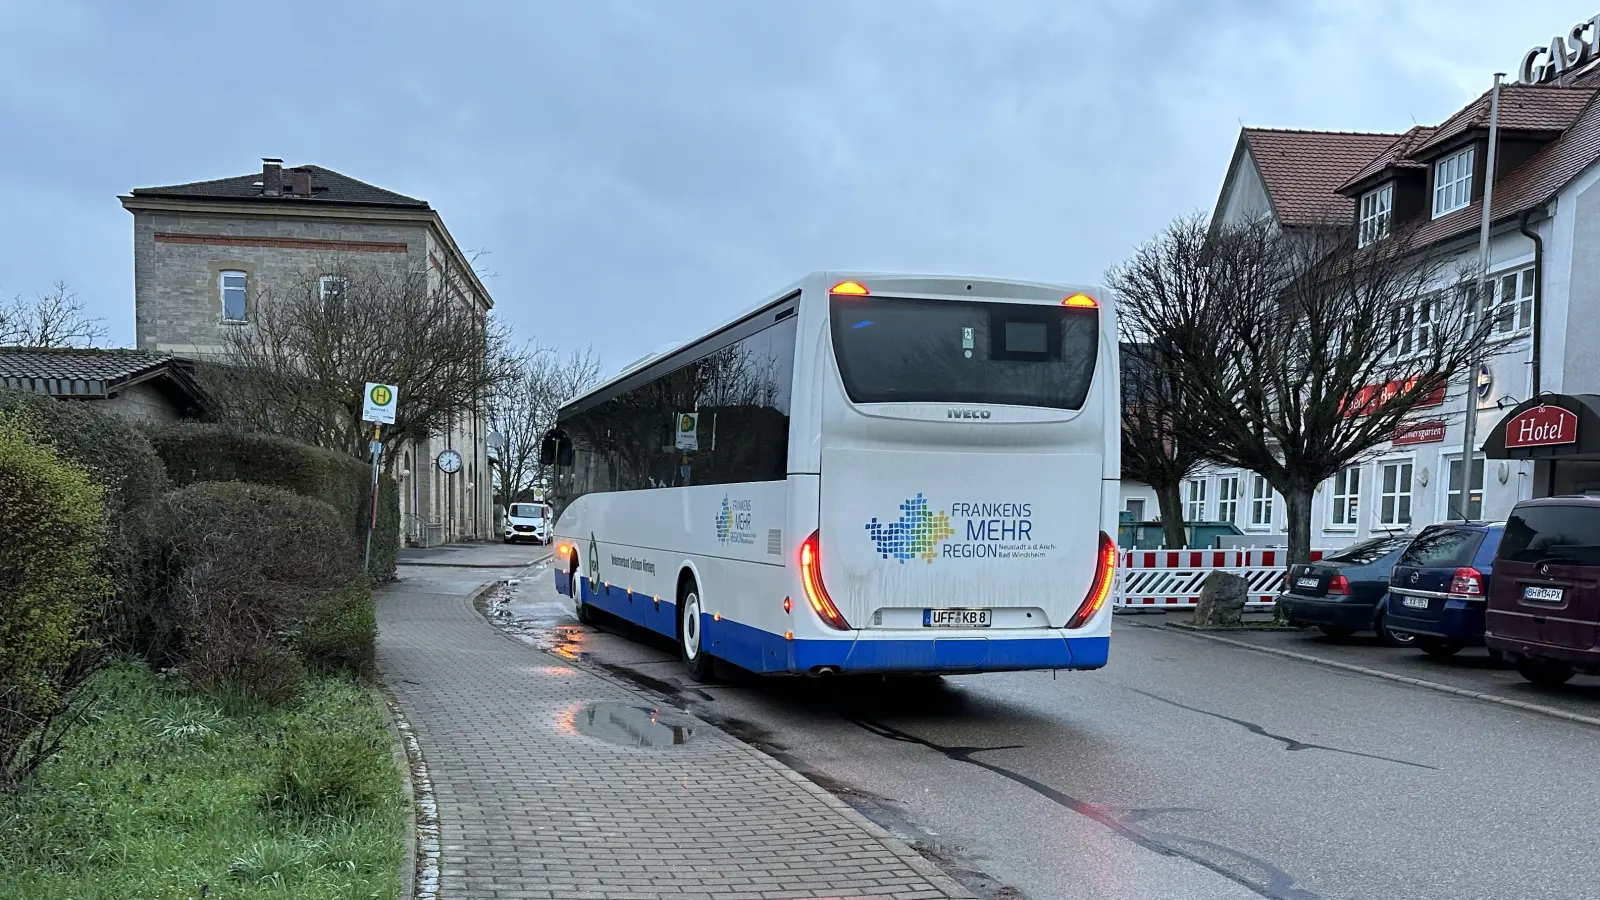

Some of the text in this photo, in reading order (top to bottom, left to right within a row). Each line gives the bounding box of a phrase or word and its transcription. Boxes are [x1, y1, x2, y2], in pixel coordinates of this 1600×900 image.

[948, 409, 991, 419] IVECO
[1518, 413, 1565, 442] Hotel
[733, 499, 751, 511] FRANKENS
[952, 503, 1032, 517] FRANKENS
[735, 513, 751, 530] MEHR
[966, 519, 1032, 541] MEHR
[943, 544, 998, 558] REGION
[933, 611, 955, 623] UFF
[962, 611, 977, 623] KB
[979, 611, 986, 622] 8
